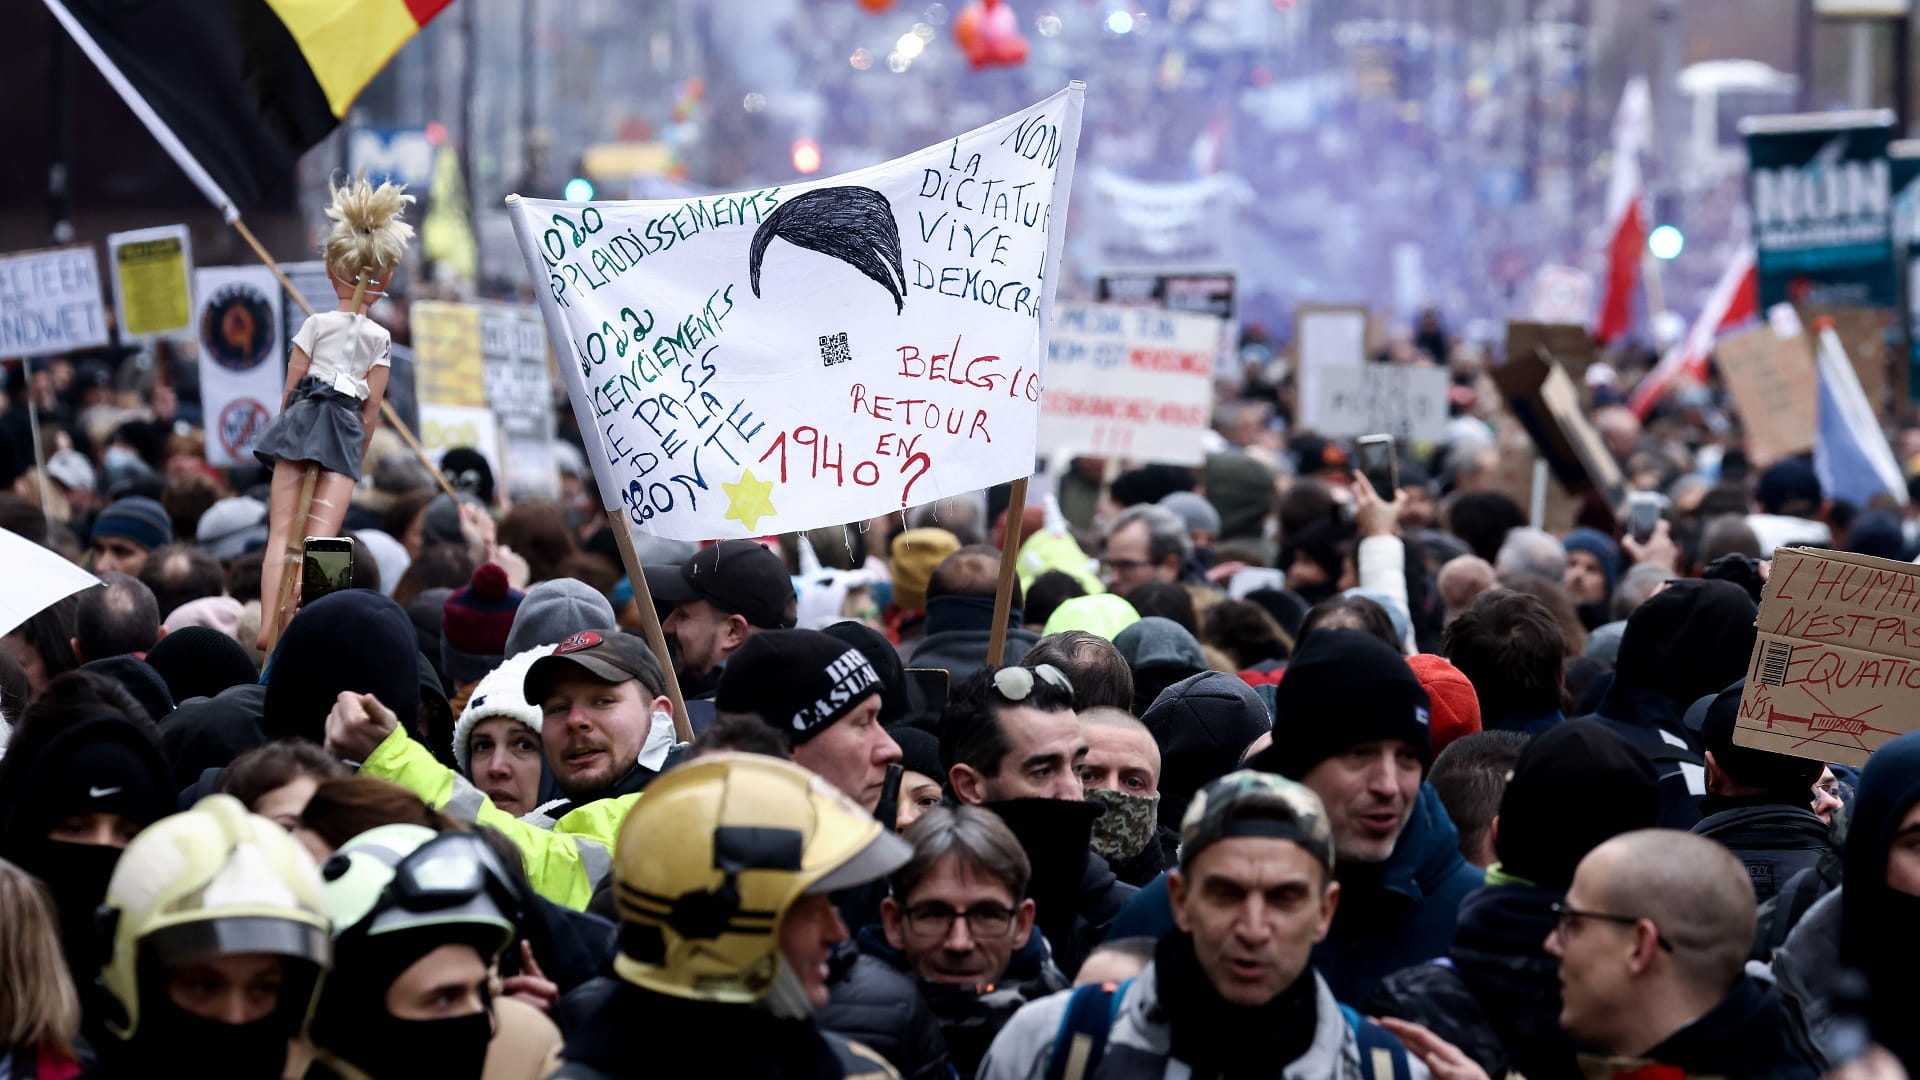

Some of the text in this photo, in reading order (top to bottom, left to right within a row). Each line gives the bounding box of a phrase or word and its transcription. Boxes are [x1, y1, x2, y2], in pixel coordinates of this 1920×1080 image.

[949, 137, 982, 177] LA
[1001, 114, 1062, 169] NON
[540, 206, 604, 273] 020
[603, 344, 720, 465] LE PASS
[851, 383, 992, 443] RETOUR
[630, 391, 723, 479] DE LA
[876, 433, 922, 458] EN
